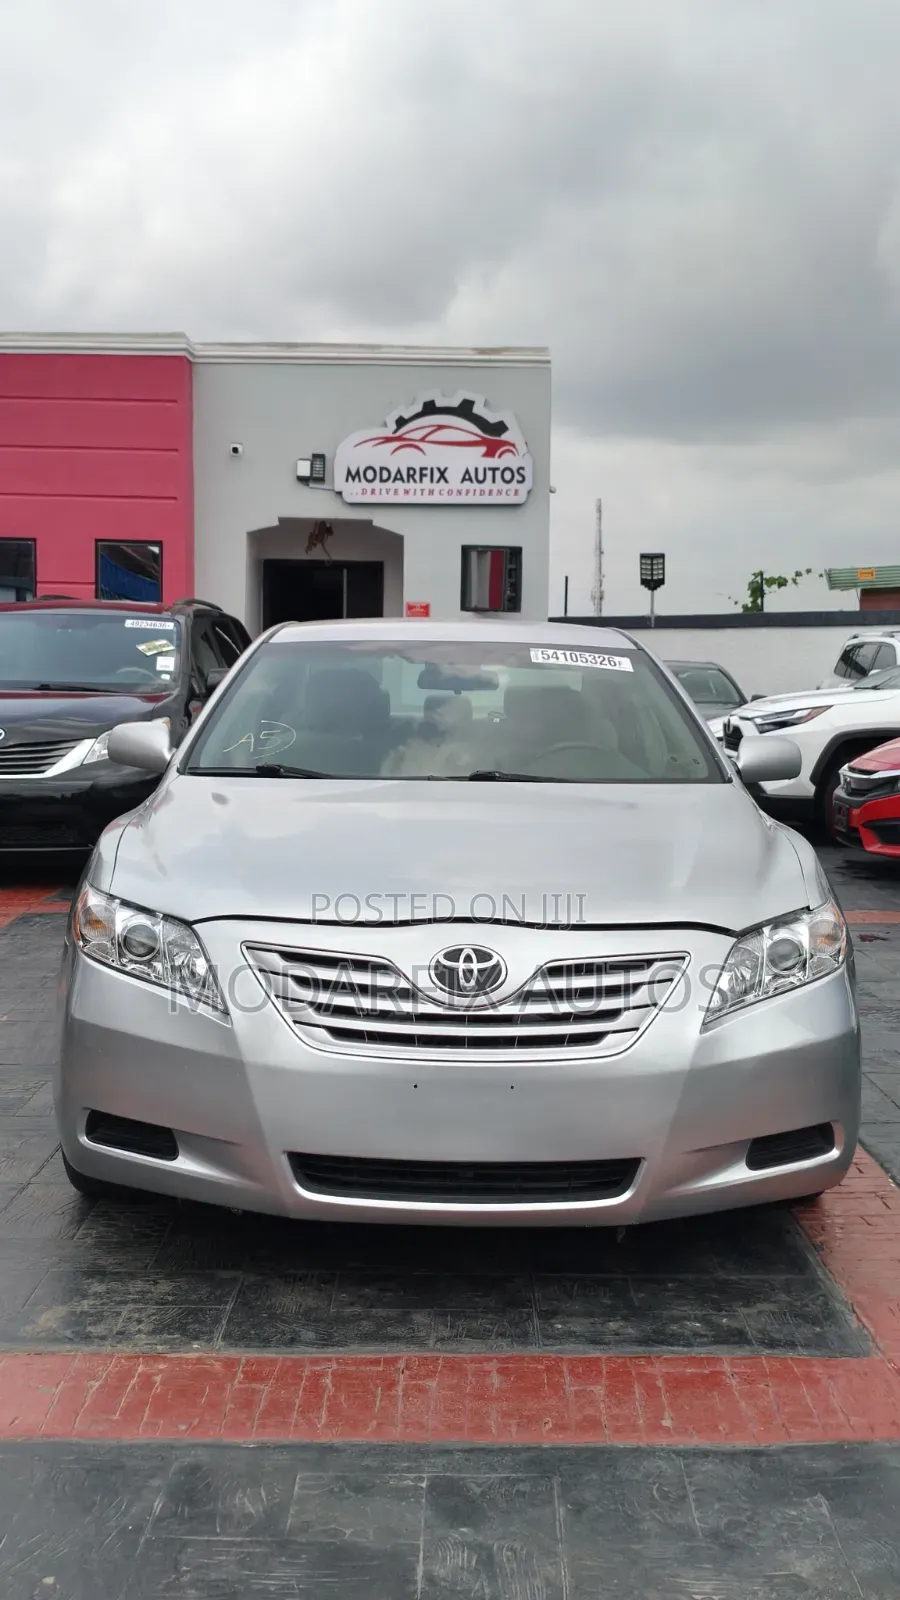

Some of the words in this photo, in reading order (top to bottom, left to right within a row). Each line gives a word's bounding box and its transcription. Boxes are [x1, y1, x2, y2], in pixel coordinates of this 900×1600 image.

[345, 466, 449, 484] MODARFIX
[460, 466, 526, 484] AUTOS
[403, 488, 435, 496] WITH
[439, 488, 520, 496] CONFIDENCE
[540, 650, 617, 667] 54105326
